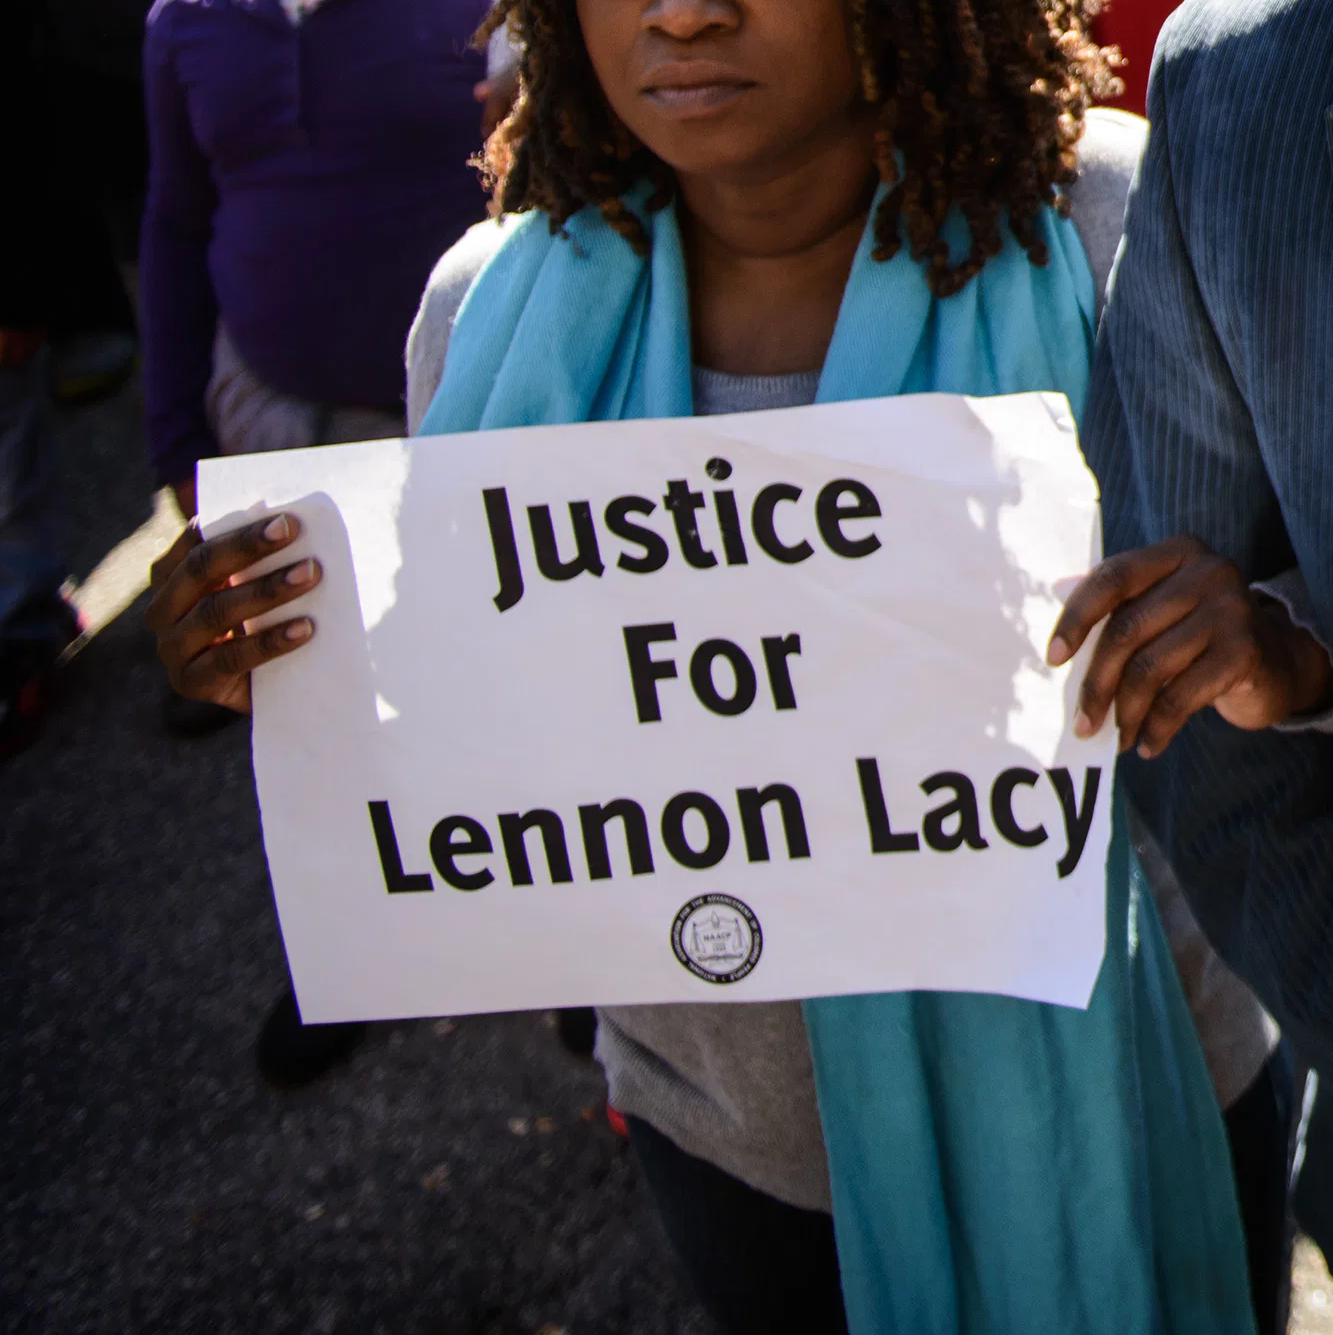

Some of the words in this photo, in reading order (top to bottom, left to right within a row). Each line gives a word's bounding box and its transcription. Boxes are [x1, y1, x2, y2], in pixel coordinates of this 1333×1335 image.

[481, 456, 883, 614] Justice
[621, 621, 803, 725] For
[367, 782, 812, 895] Lennon
[855, 757, 1103, 879] Lacy
